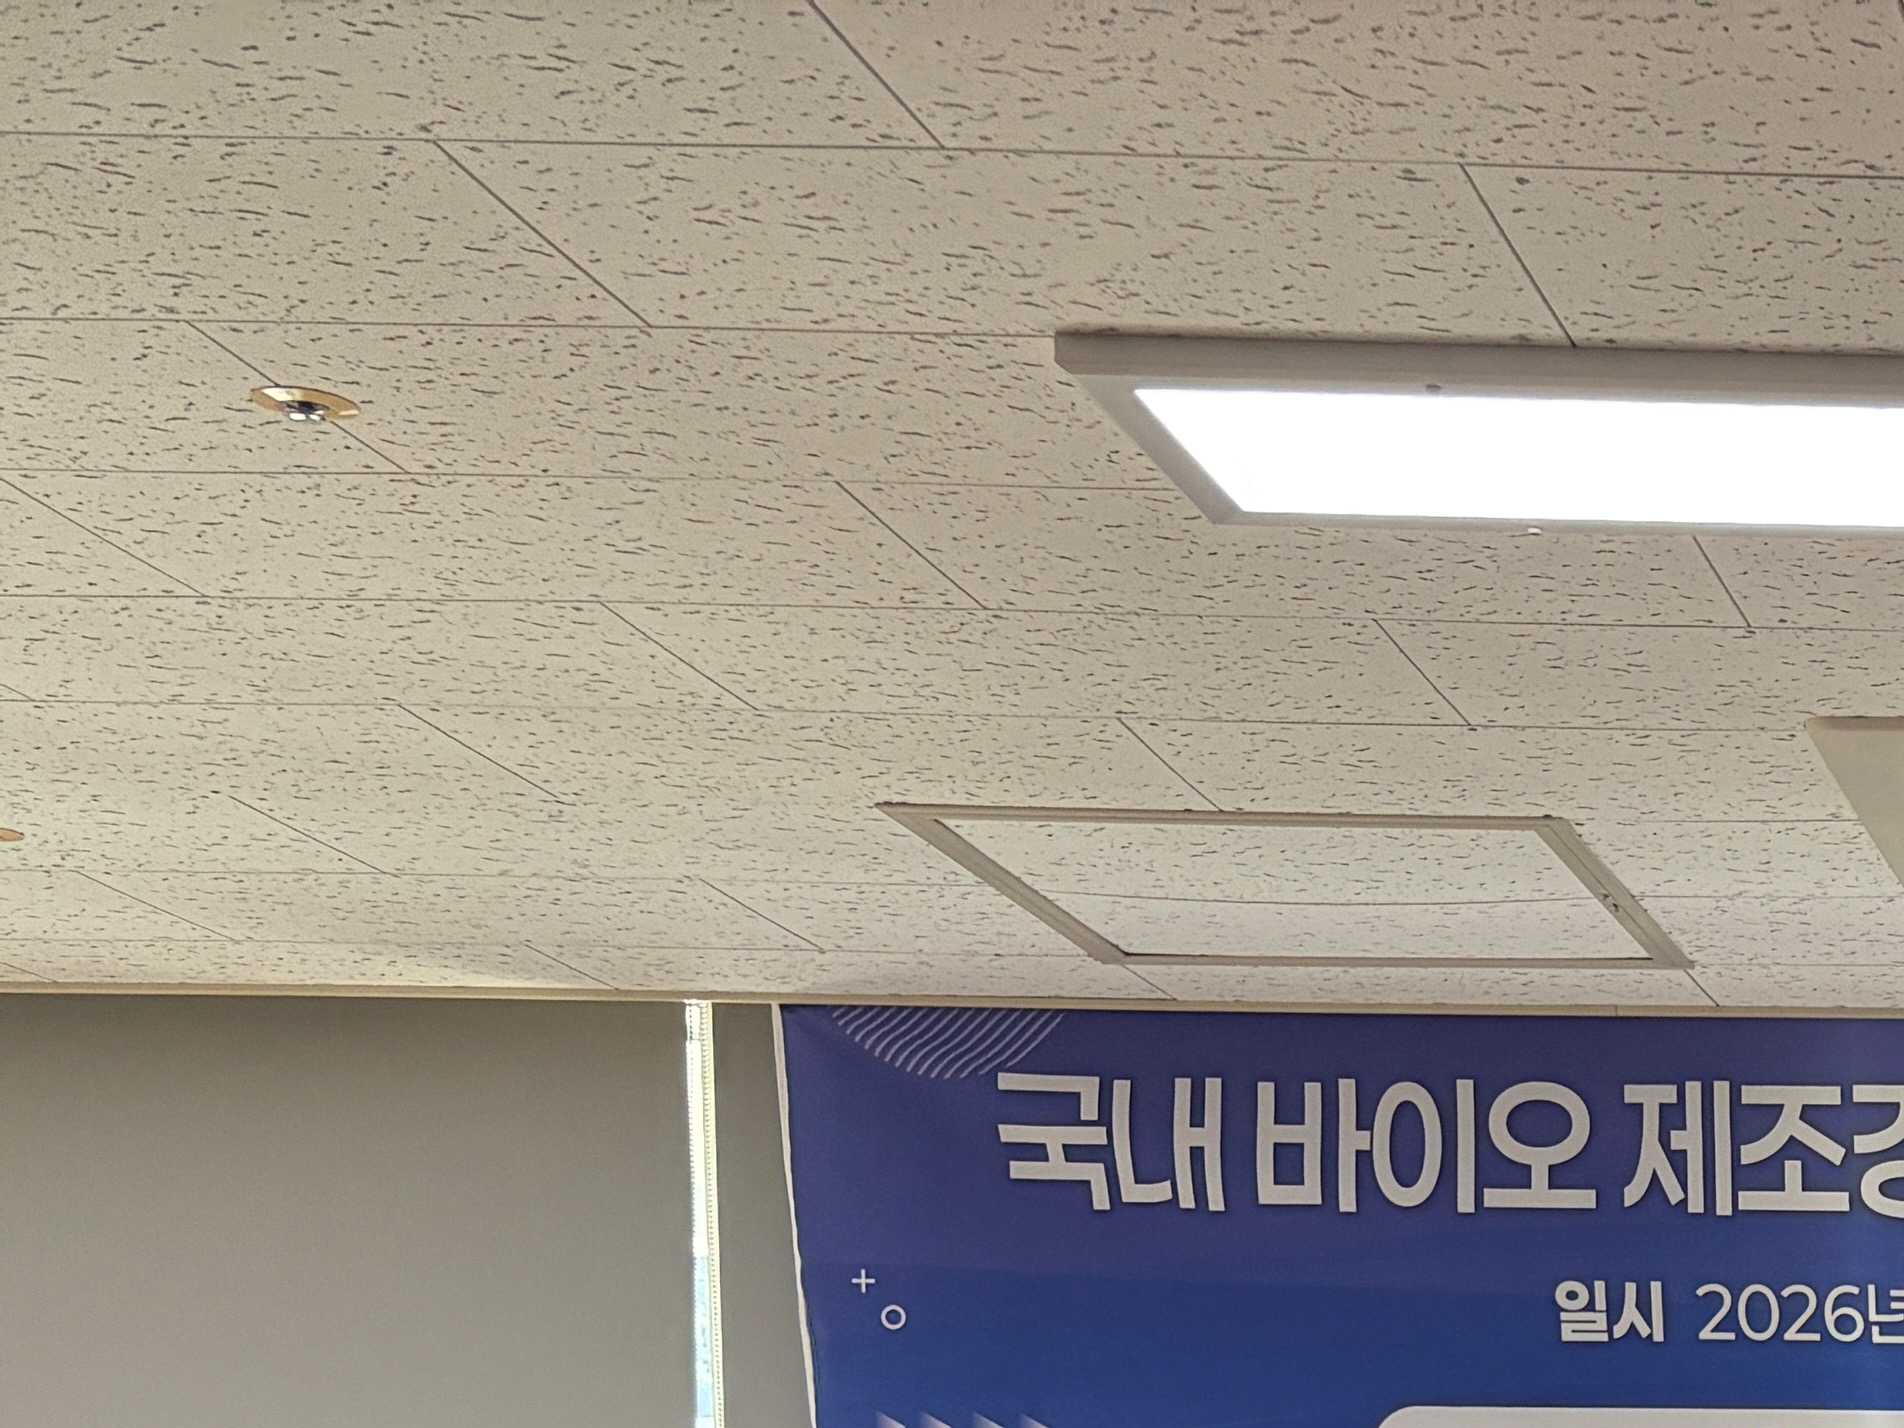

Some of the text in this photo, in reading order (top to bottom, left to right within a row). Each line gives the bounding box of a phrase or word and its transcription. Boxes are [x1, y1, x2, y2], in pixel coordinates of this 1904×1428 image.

[998, 1072, 1225, 1212] 국내
[1256, 1078, 1598, 1214] 바이오
[1555, 1280, 1665, 1342] 일시
